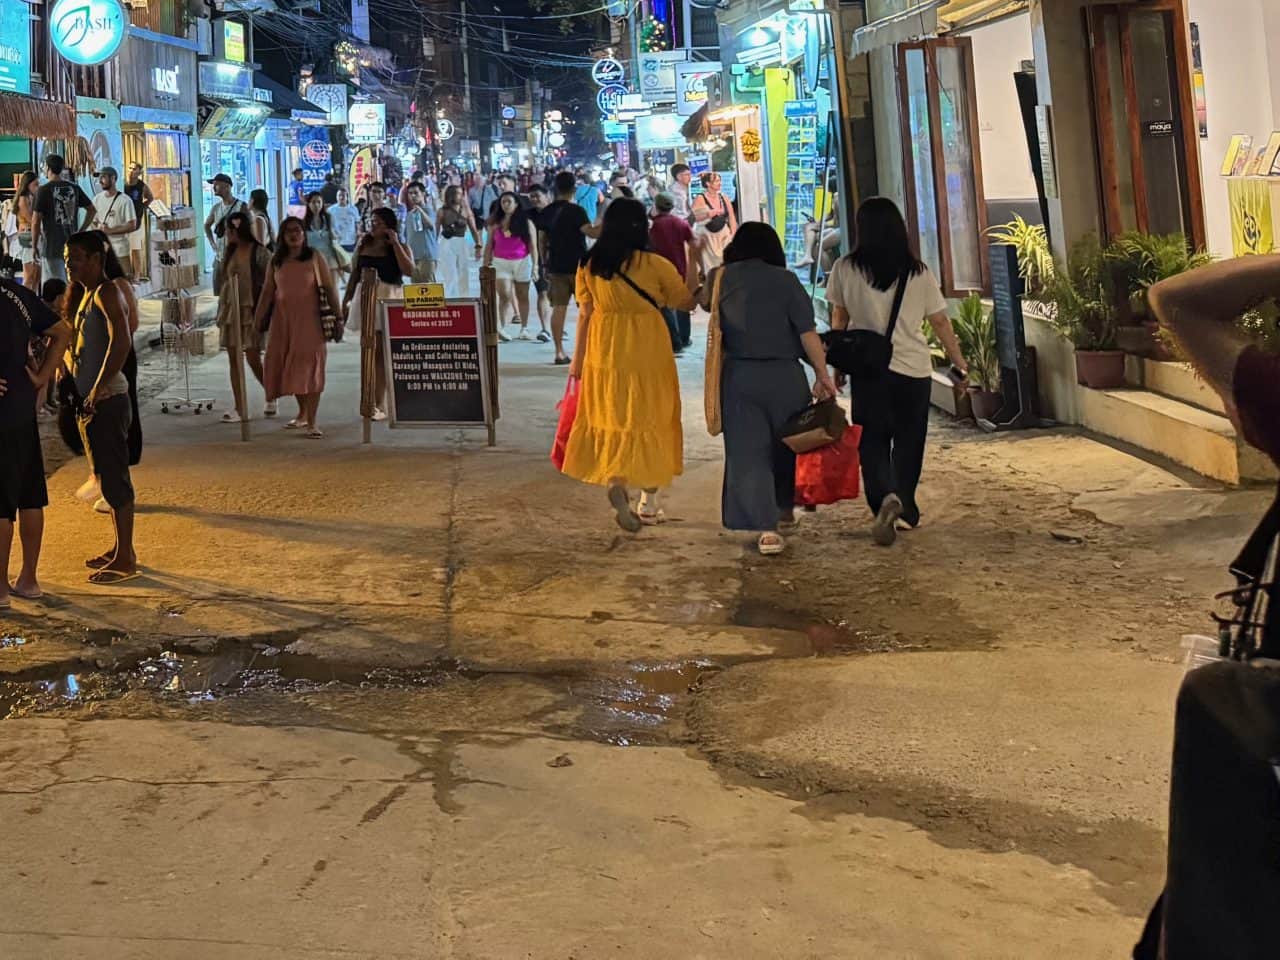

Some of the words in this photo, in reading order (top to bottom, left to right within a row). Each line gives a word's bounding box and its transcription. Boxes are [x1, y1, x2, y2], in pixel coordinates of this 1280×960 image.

[402, 343, 410, 351] An
[410, 343, 440, 351] Ordinance
[441, 343, 470, 352] declaring
[424, 352, 435, 360] and
[393, 362, 421, 371] Barangay
[454, 361, 461, 369] El
[394, 372, 420, 380] Palawan
[464, 372, 479, 381] from
[422, 382, 433, 390] PM
[434, 382, 441, 390] to
[458, 382, 468, 390] AM
